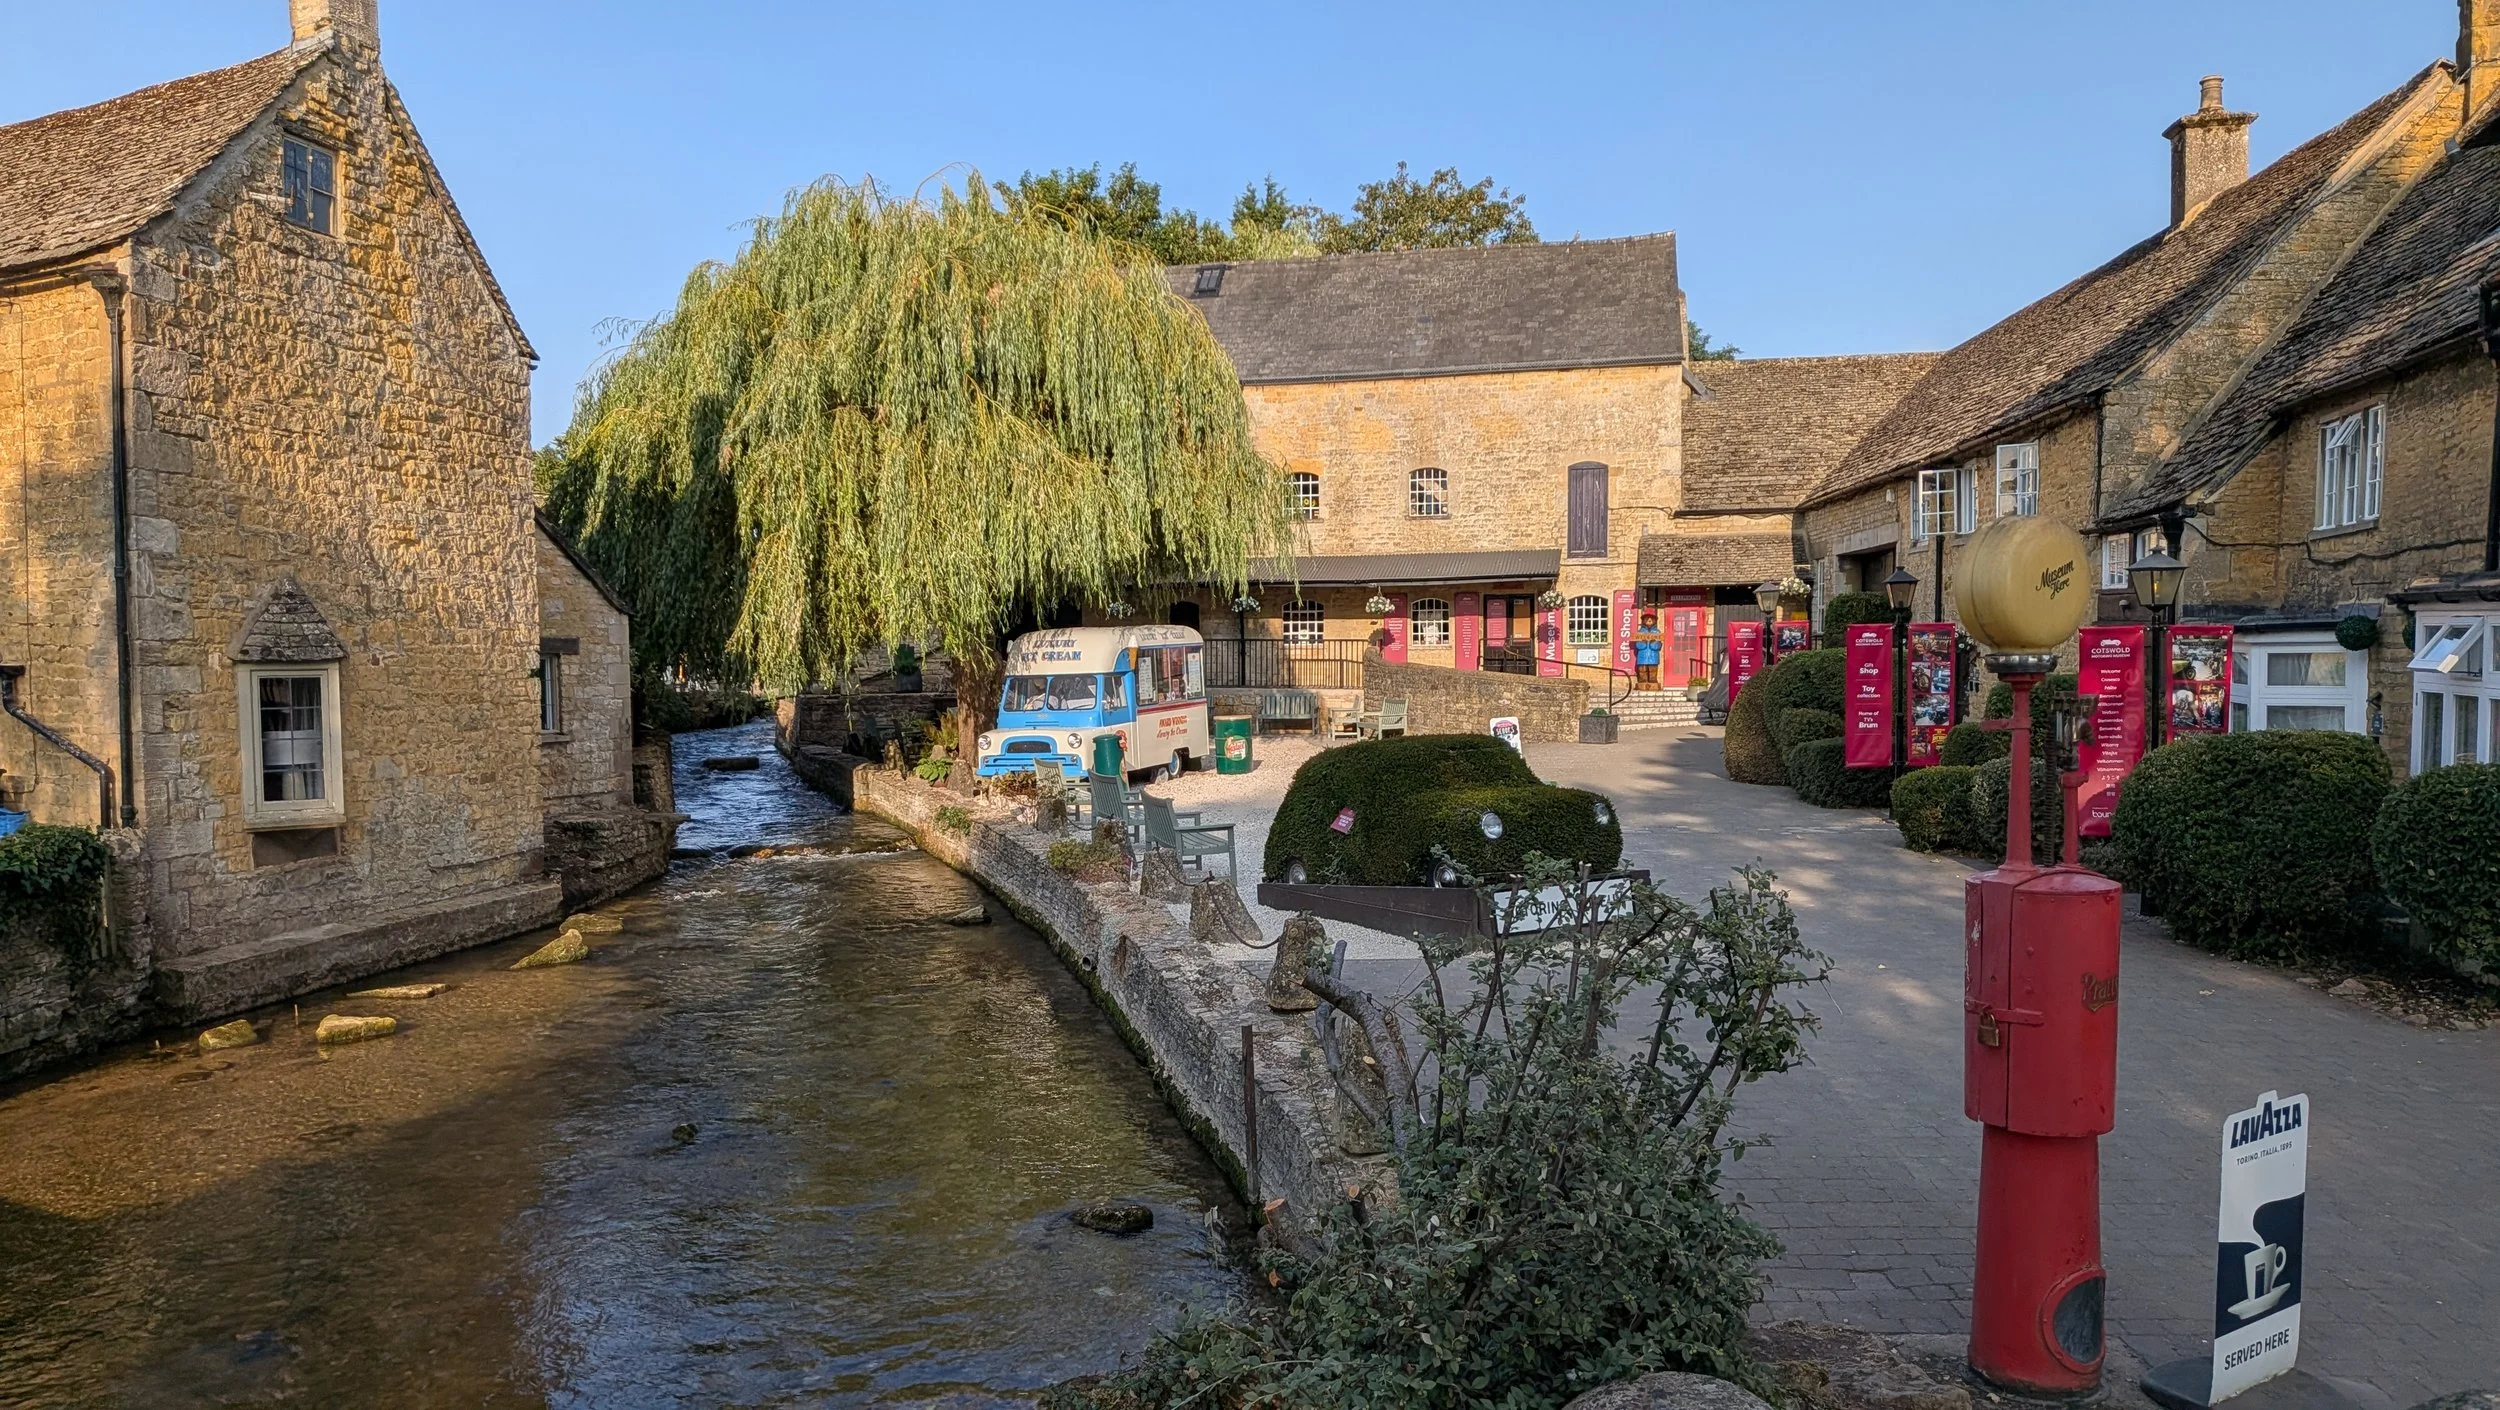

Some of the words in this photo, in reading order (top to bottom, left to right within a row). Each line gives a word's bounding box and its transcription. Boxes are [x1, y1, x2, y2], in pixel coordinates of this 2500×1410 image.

[2035, 560, 2075, 591] Museum
[2050, 577, 2070, 599] Here
[1620, 609, 1633, 638] Shop
[1033, 639, 1077, 648] LUXURY
[1545, 611, 1556, 660] Museum
[1041, 650, 1082, 661] CREAM
[1620, 640, 1631, 662] Gift
[1859, 667, 1879, 675] Shop
[1862, 685, 1876, 693] Toy
[1858, 721, 1879, 729] Brum
[2230, 1101, 2302, 1149] LAVAZZA
[2280, 1141, 2292, 1151] 1895
[2224, 1341, 2263, 1370] SERVED
[2264, 1328, 2290, 1352] HERE
